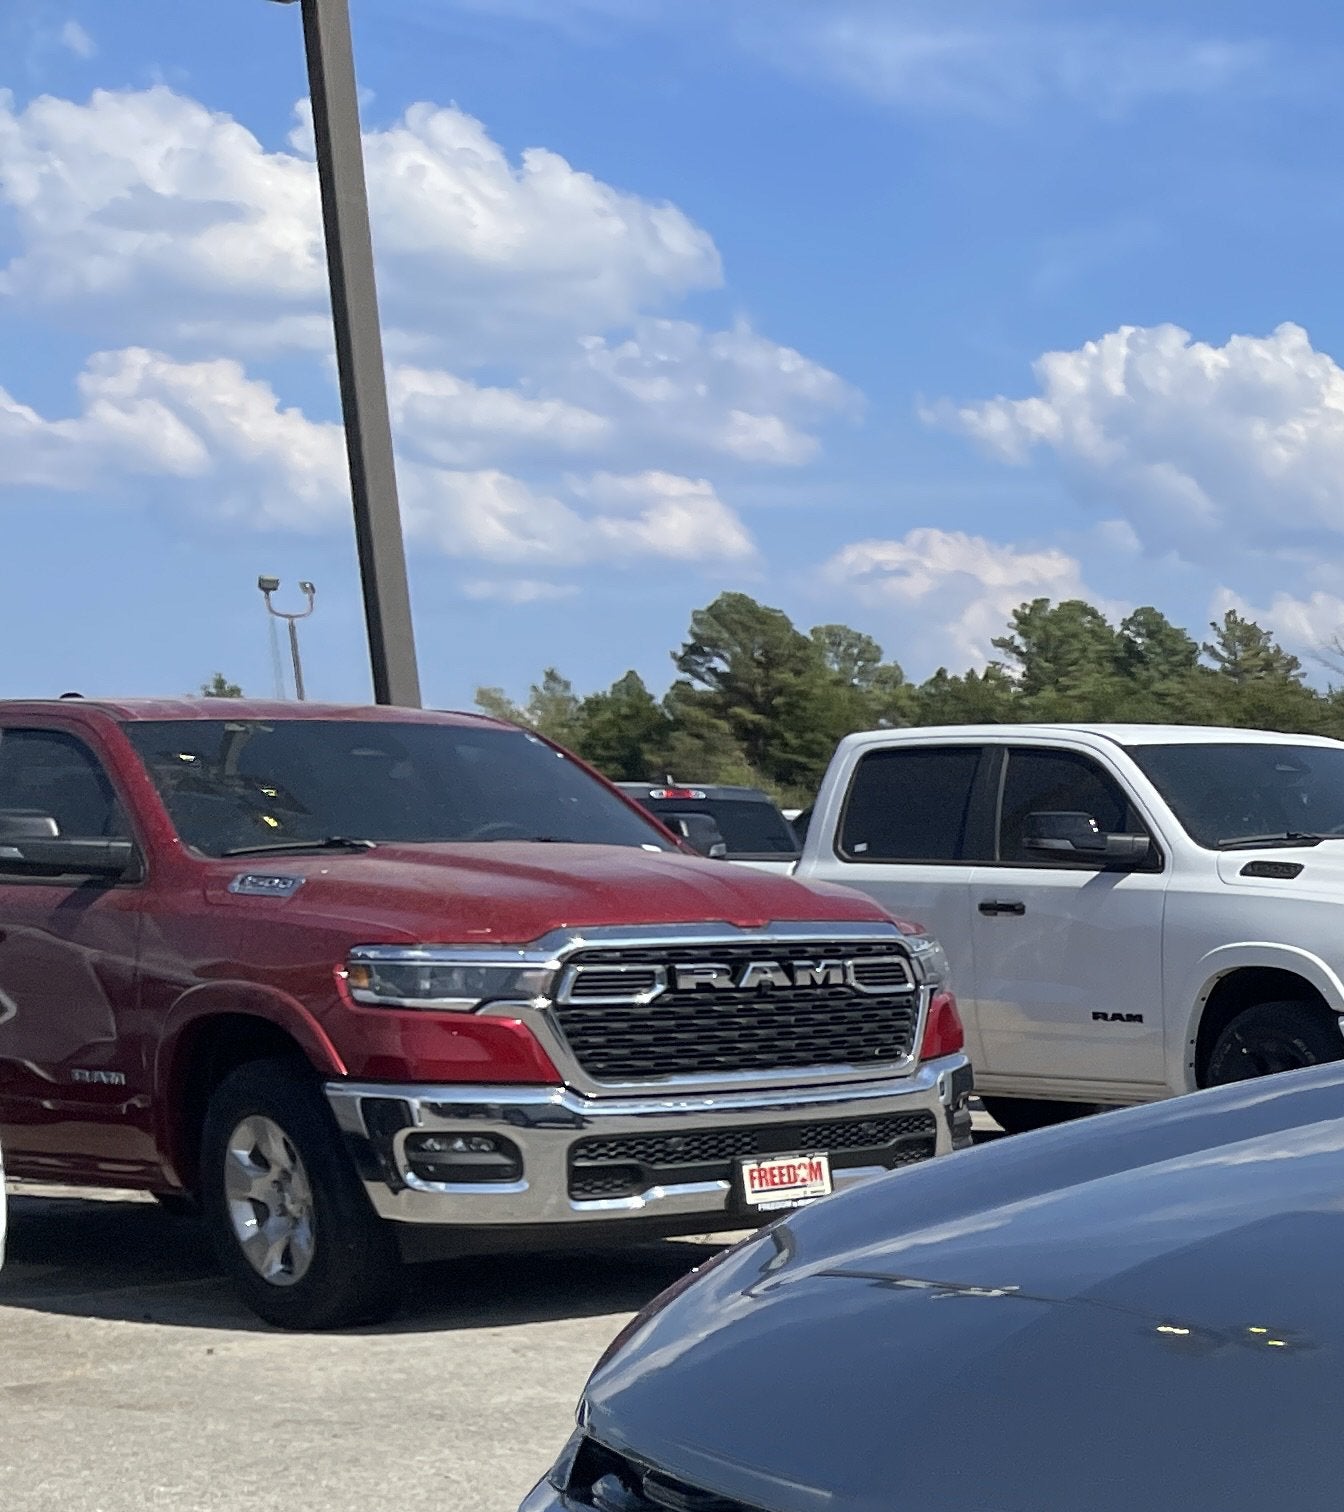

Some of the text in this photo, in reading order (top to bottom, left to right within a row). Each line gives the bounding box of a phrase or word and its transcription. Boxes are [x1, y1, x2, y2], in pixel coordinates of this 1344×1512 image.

[674, 959, 844, 990] RAM
[1092, 1011, 1144, 1023] RAM
[749, 1161, 823, 1189] FREEDOM
